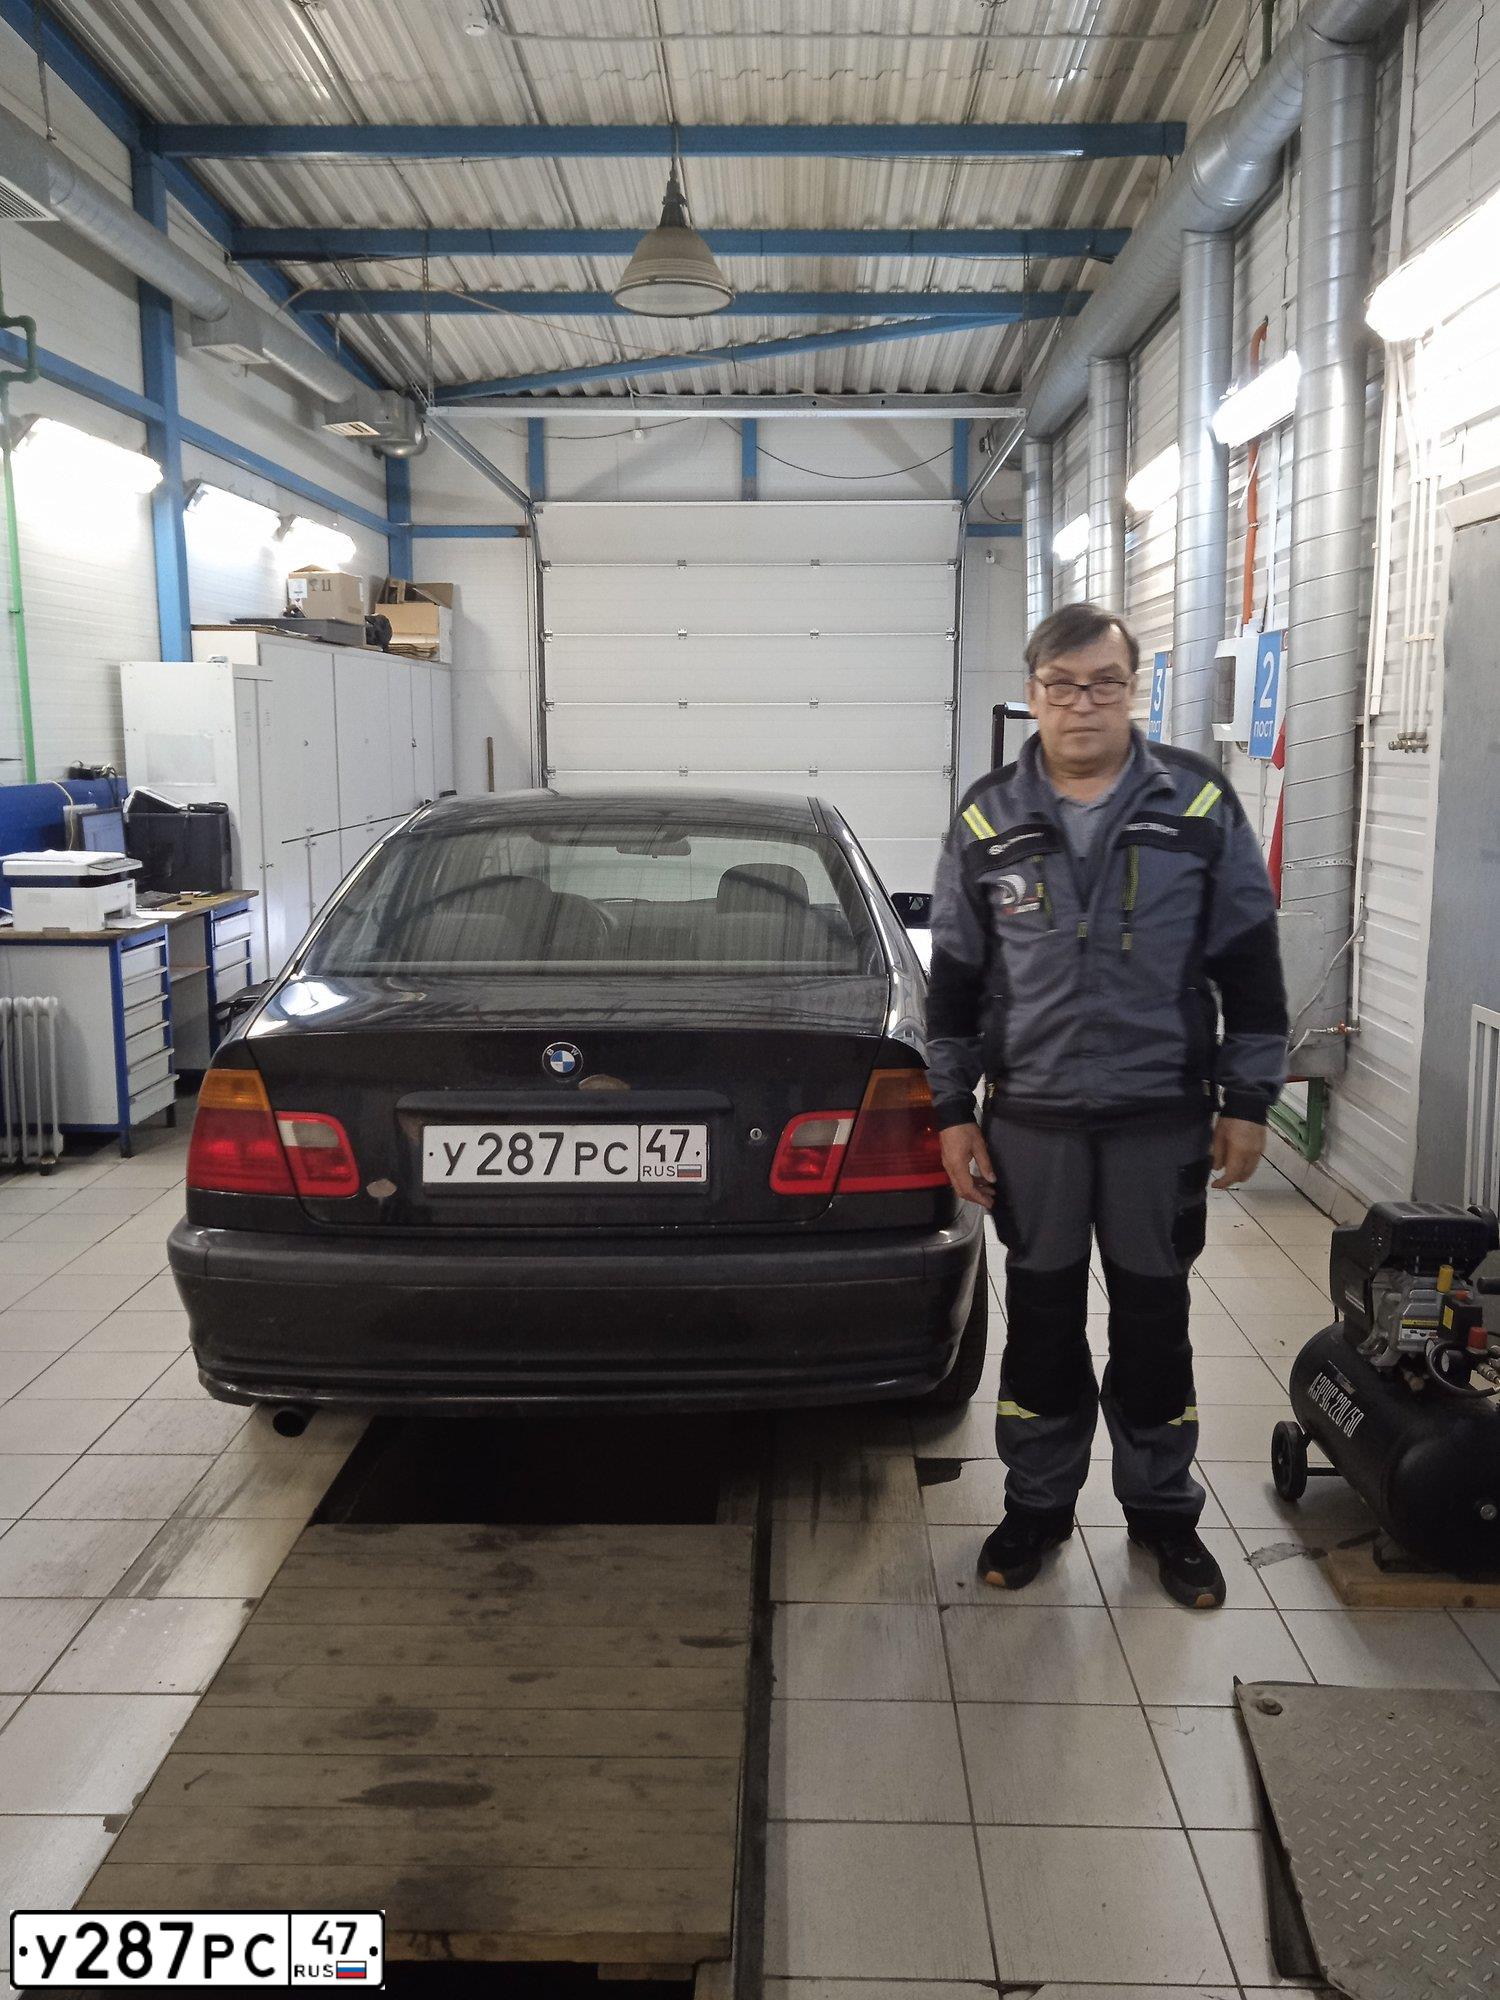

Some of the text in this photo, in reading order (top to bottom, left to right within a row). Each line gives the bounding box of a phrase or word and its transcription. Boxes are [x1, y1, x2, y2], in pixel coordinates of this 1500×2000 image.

[1153, 668, 1163, 711] 3
[1260, 651, 1275, 708] 2
[1253, 720, 1273, 737] ПОСТ
[443, 1128, 691, 1176] У287РС 47
[642, 1164, 676, 1177] RUS
[1307, 1371, 1339, 1412] АЭРУС
[1327, 1391, 1365, 1438] 220/50
